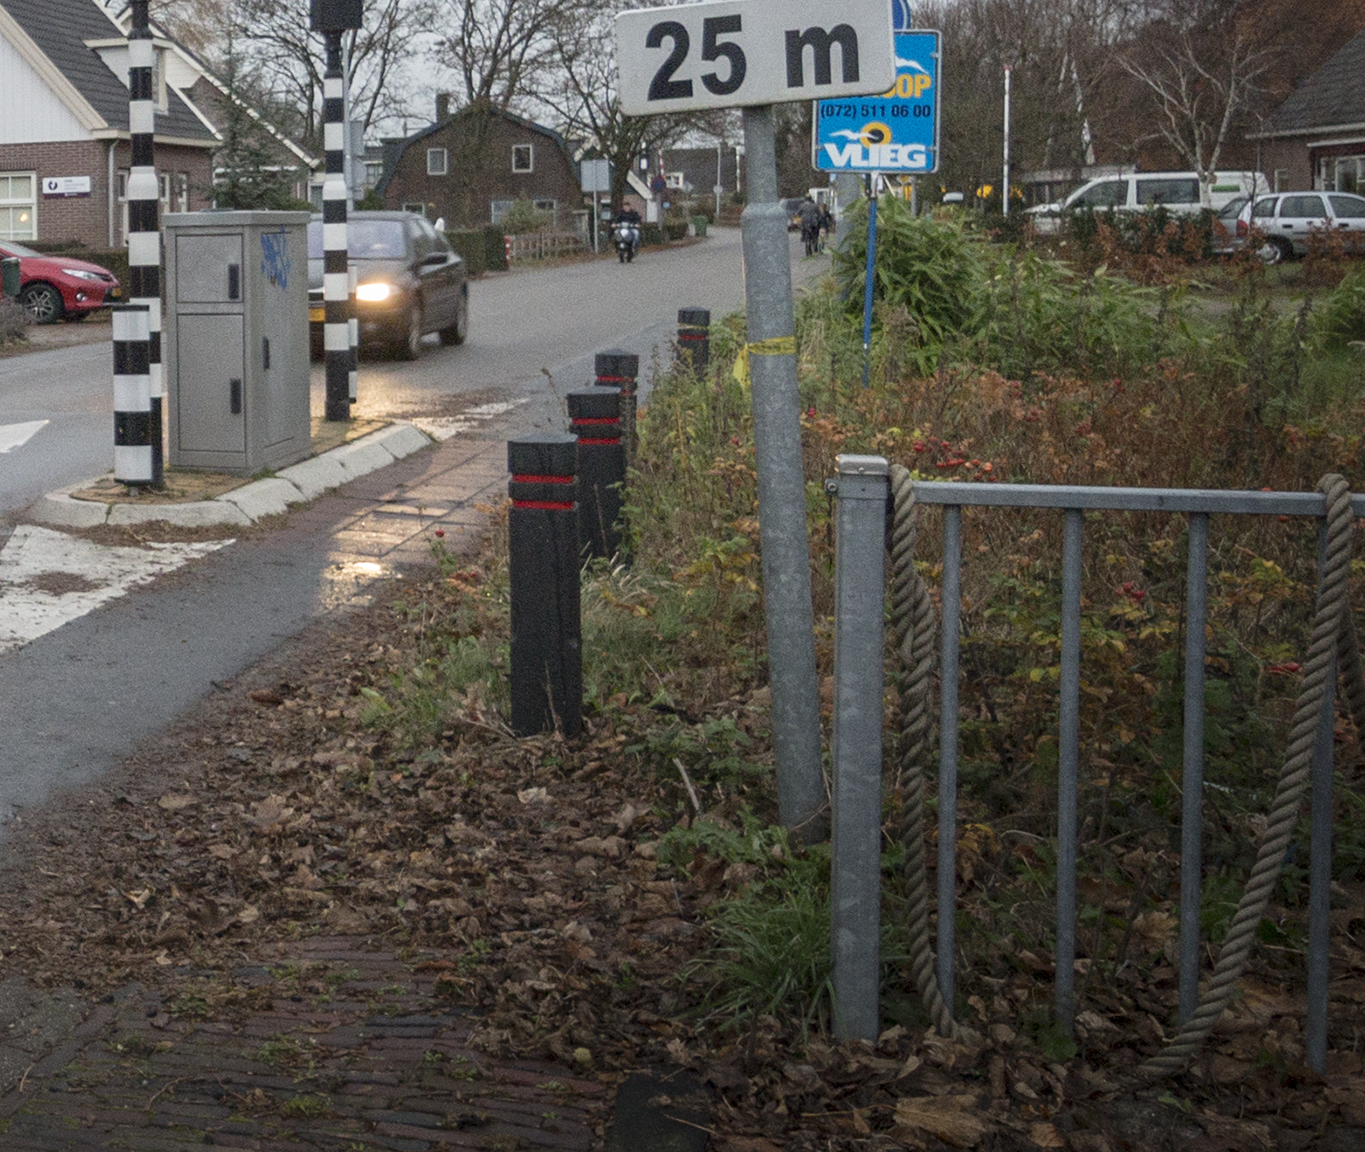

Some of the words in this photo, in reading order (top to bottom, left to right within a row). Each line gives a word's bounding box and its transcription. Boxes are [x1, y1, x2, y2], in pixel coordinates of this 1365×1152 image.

[645, 13, 747, 102] 25
[784, 23, 860, 89] m
[821, 104, 857, 119] (072)
[861, 104, 885, 118] 511
[891, 104, 910, 118] 06
[913, 104, 931, 118] 00
[823, 143, 927, 168] VLIEG
